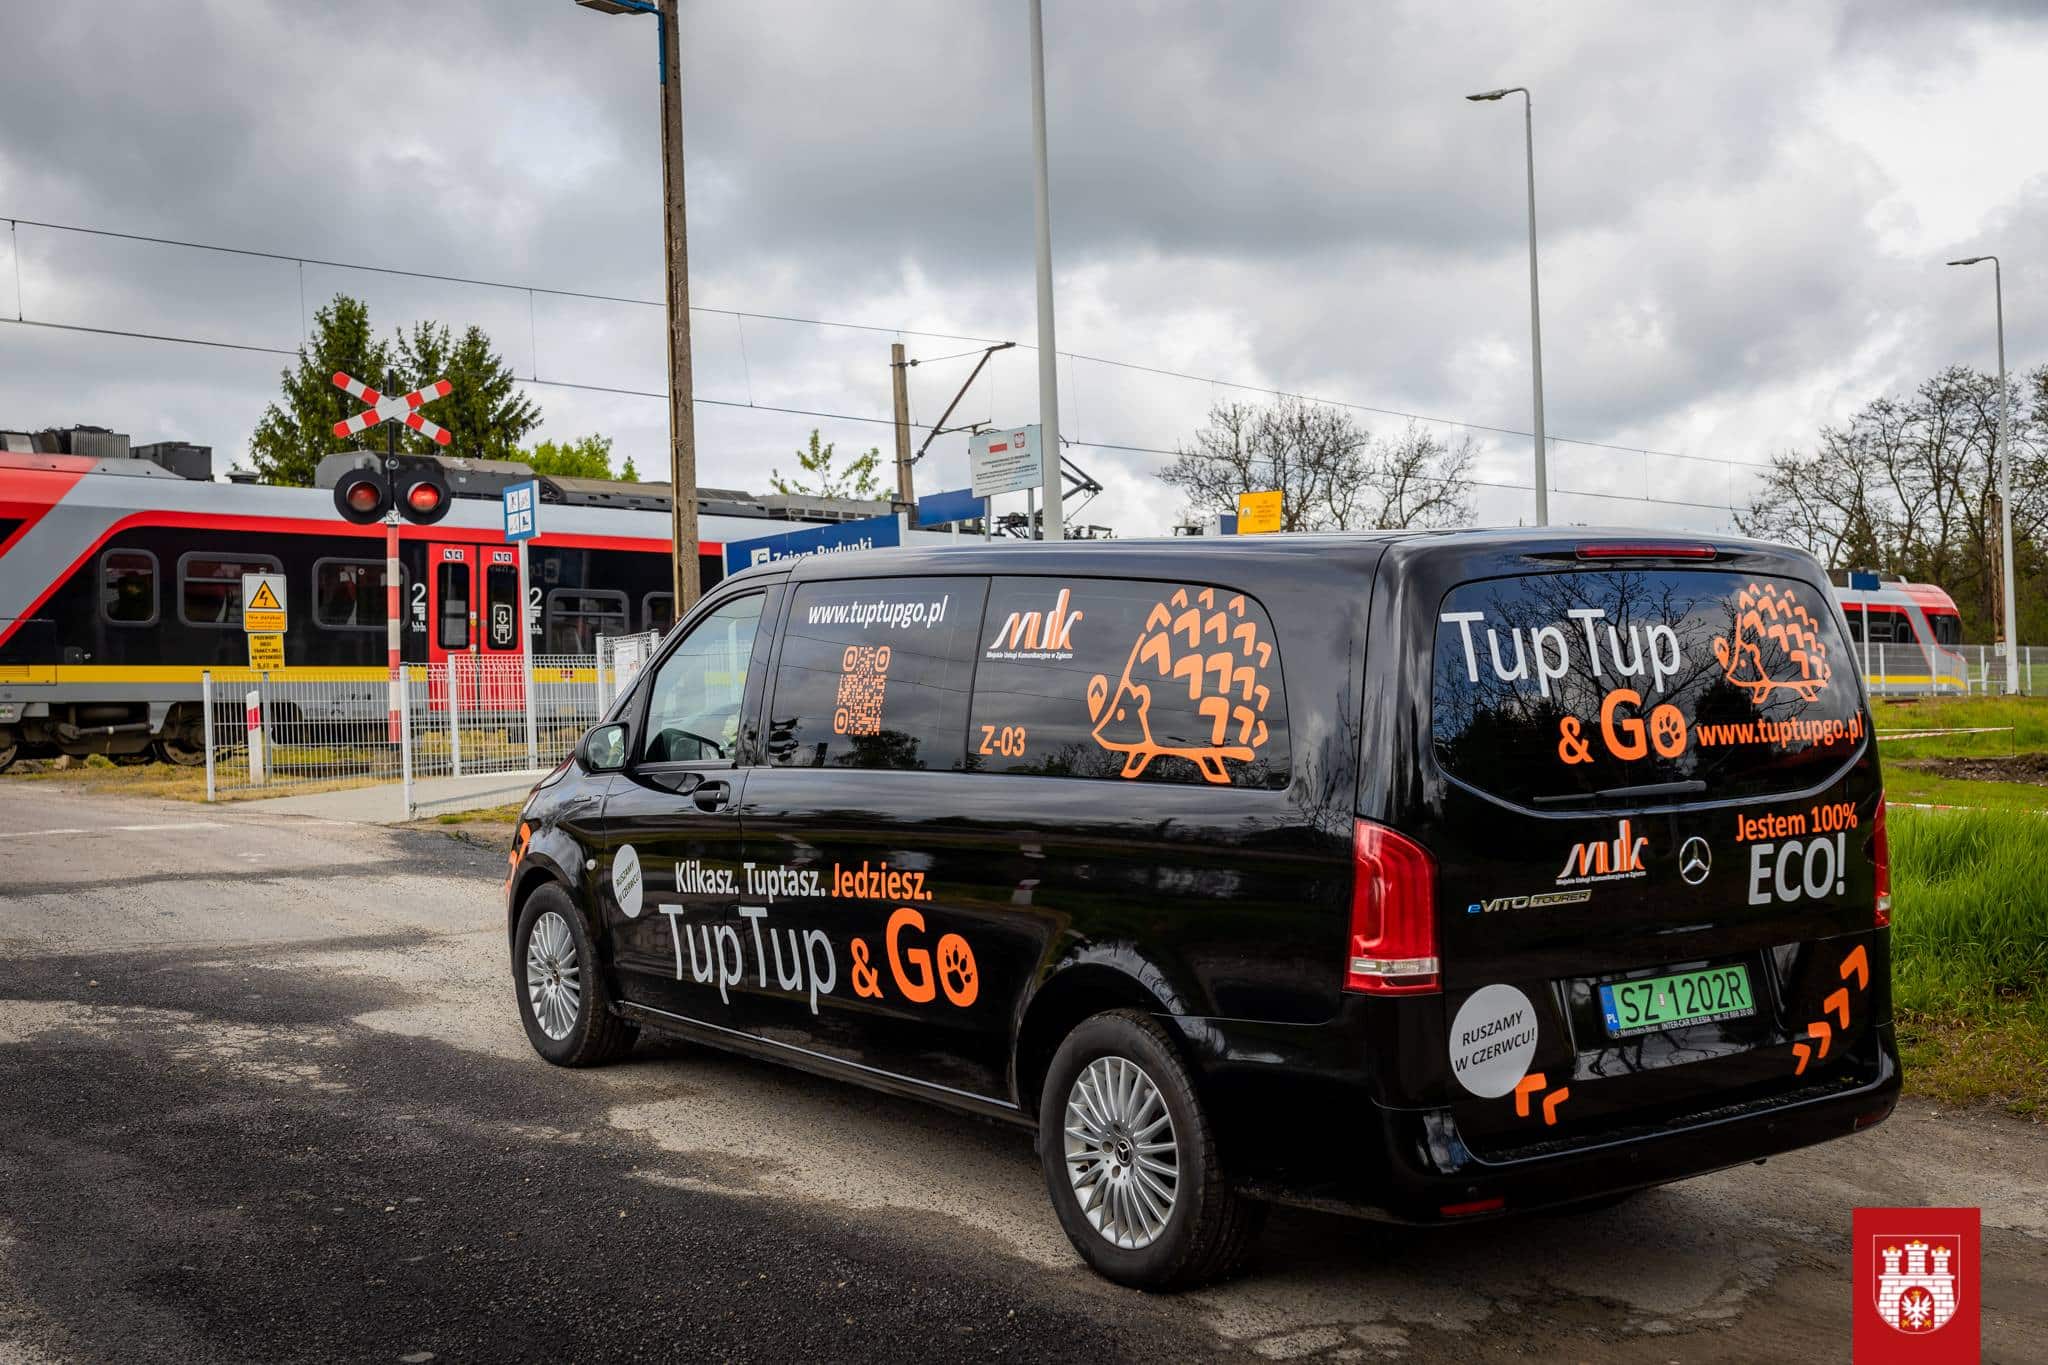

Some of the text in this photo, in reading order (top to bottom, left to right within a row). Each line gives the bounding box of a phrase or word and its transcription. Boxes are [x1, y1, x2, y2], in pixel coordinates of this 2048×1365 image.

[411, 582, 427, 607] 2
[529, 587, 543, 610] 2
[808, 594, 949, 630] www.tuptupgo.pl
[1440, 608, 1681, 698] TupTup
[979, 725, 1026, 757] Z-03
[1558, 688, 1688, 765] & Go
[1697, 711, 1864, 749] www.tuptupgo.pl
[1735, 801, 1858, 842] Jestem 100%
[675, 860, 933, 903] Klikasz. Tuptasz. Jedziesz.
[1748, 832, 1846, 905] ECO!
[658, 904, 979, 1015] TupTup & Go
[1620, 971, 1745, 1023] SZ 1202R
[1462, 1009, 1523, 1047] RUSZAMY
[1606, 1012, 1618, 1025] PL
[1455, 1027, 1535, 1072] W CZERWCU!
